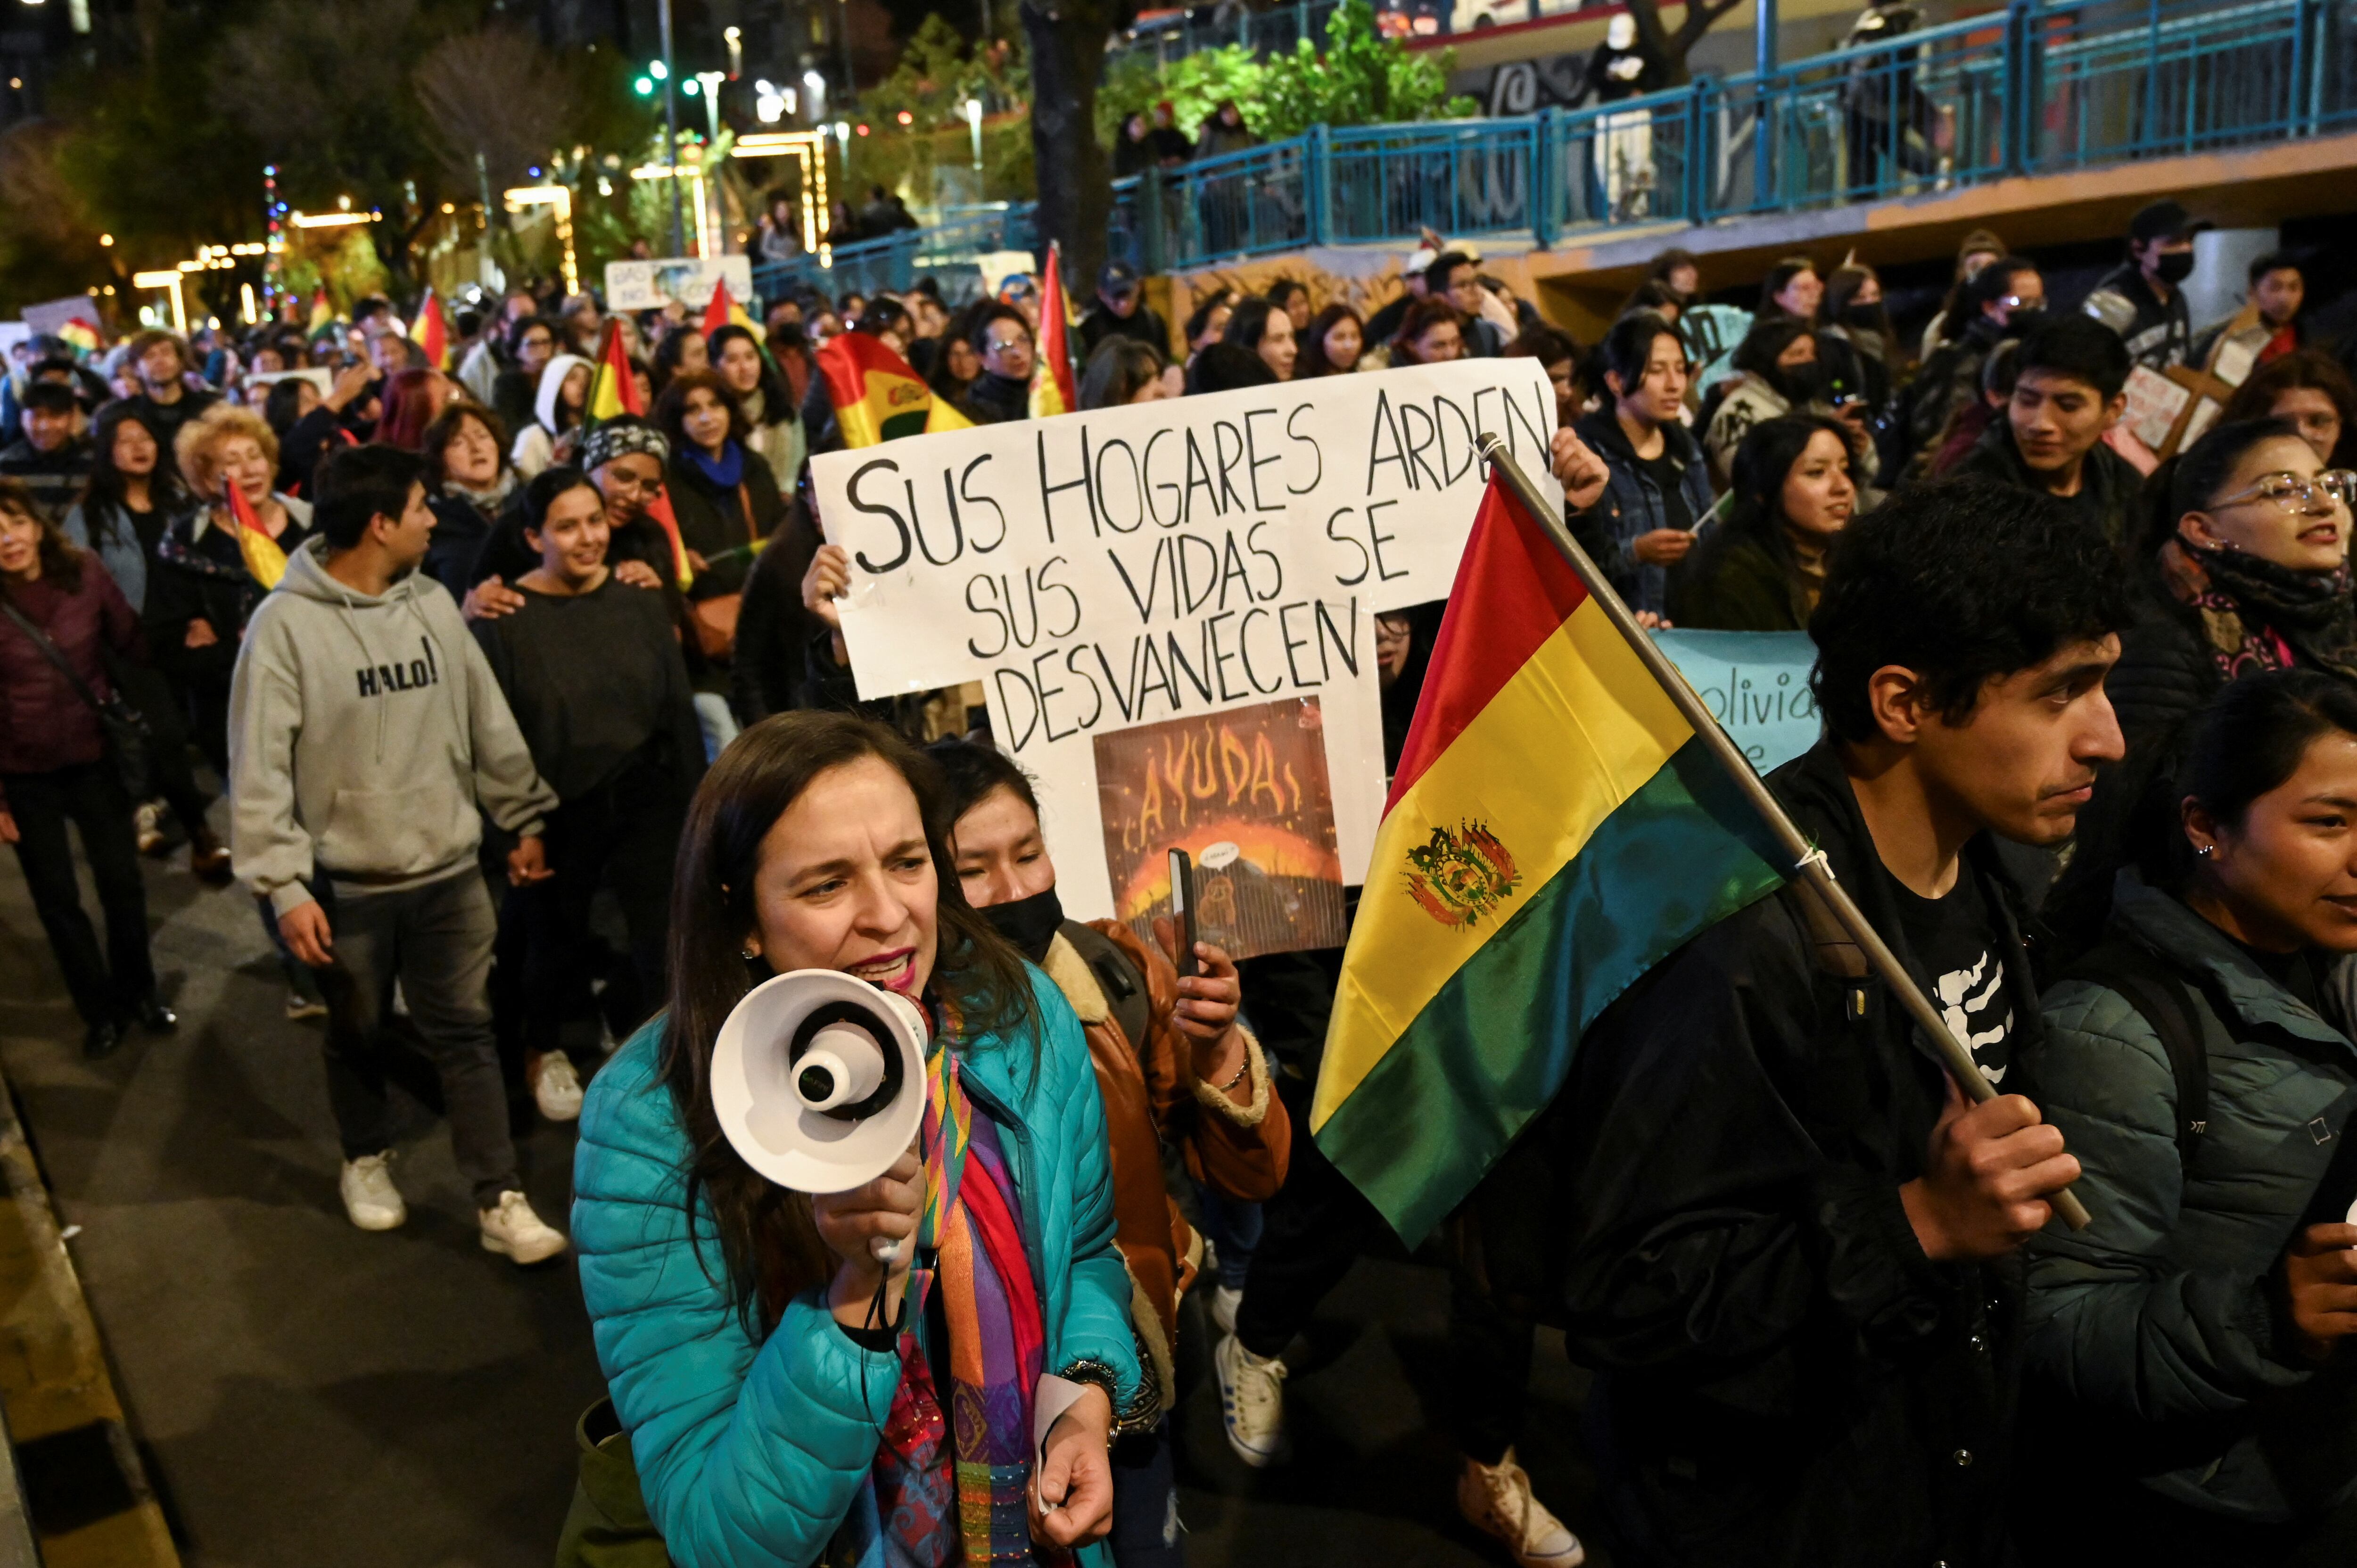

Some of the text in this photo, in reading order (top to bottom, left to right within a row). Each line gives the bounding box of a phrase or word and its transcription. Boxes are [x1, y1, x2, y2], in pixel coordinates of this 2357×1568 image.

[847, 381, 1551, 574] SUS HOGARES ARDEN
[965, 500, 1409, 659] SUS VIDAS SE
[356, 635, 438, 697] HALO!
[994, 597, 1359, 754] DESVANECEN
[1699, 667, 1817, 725] olivia
